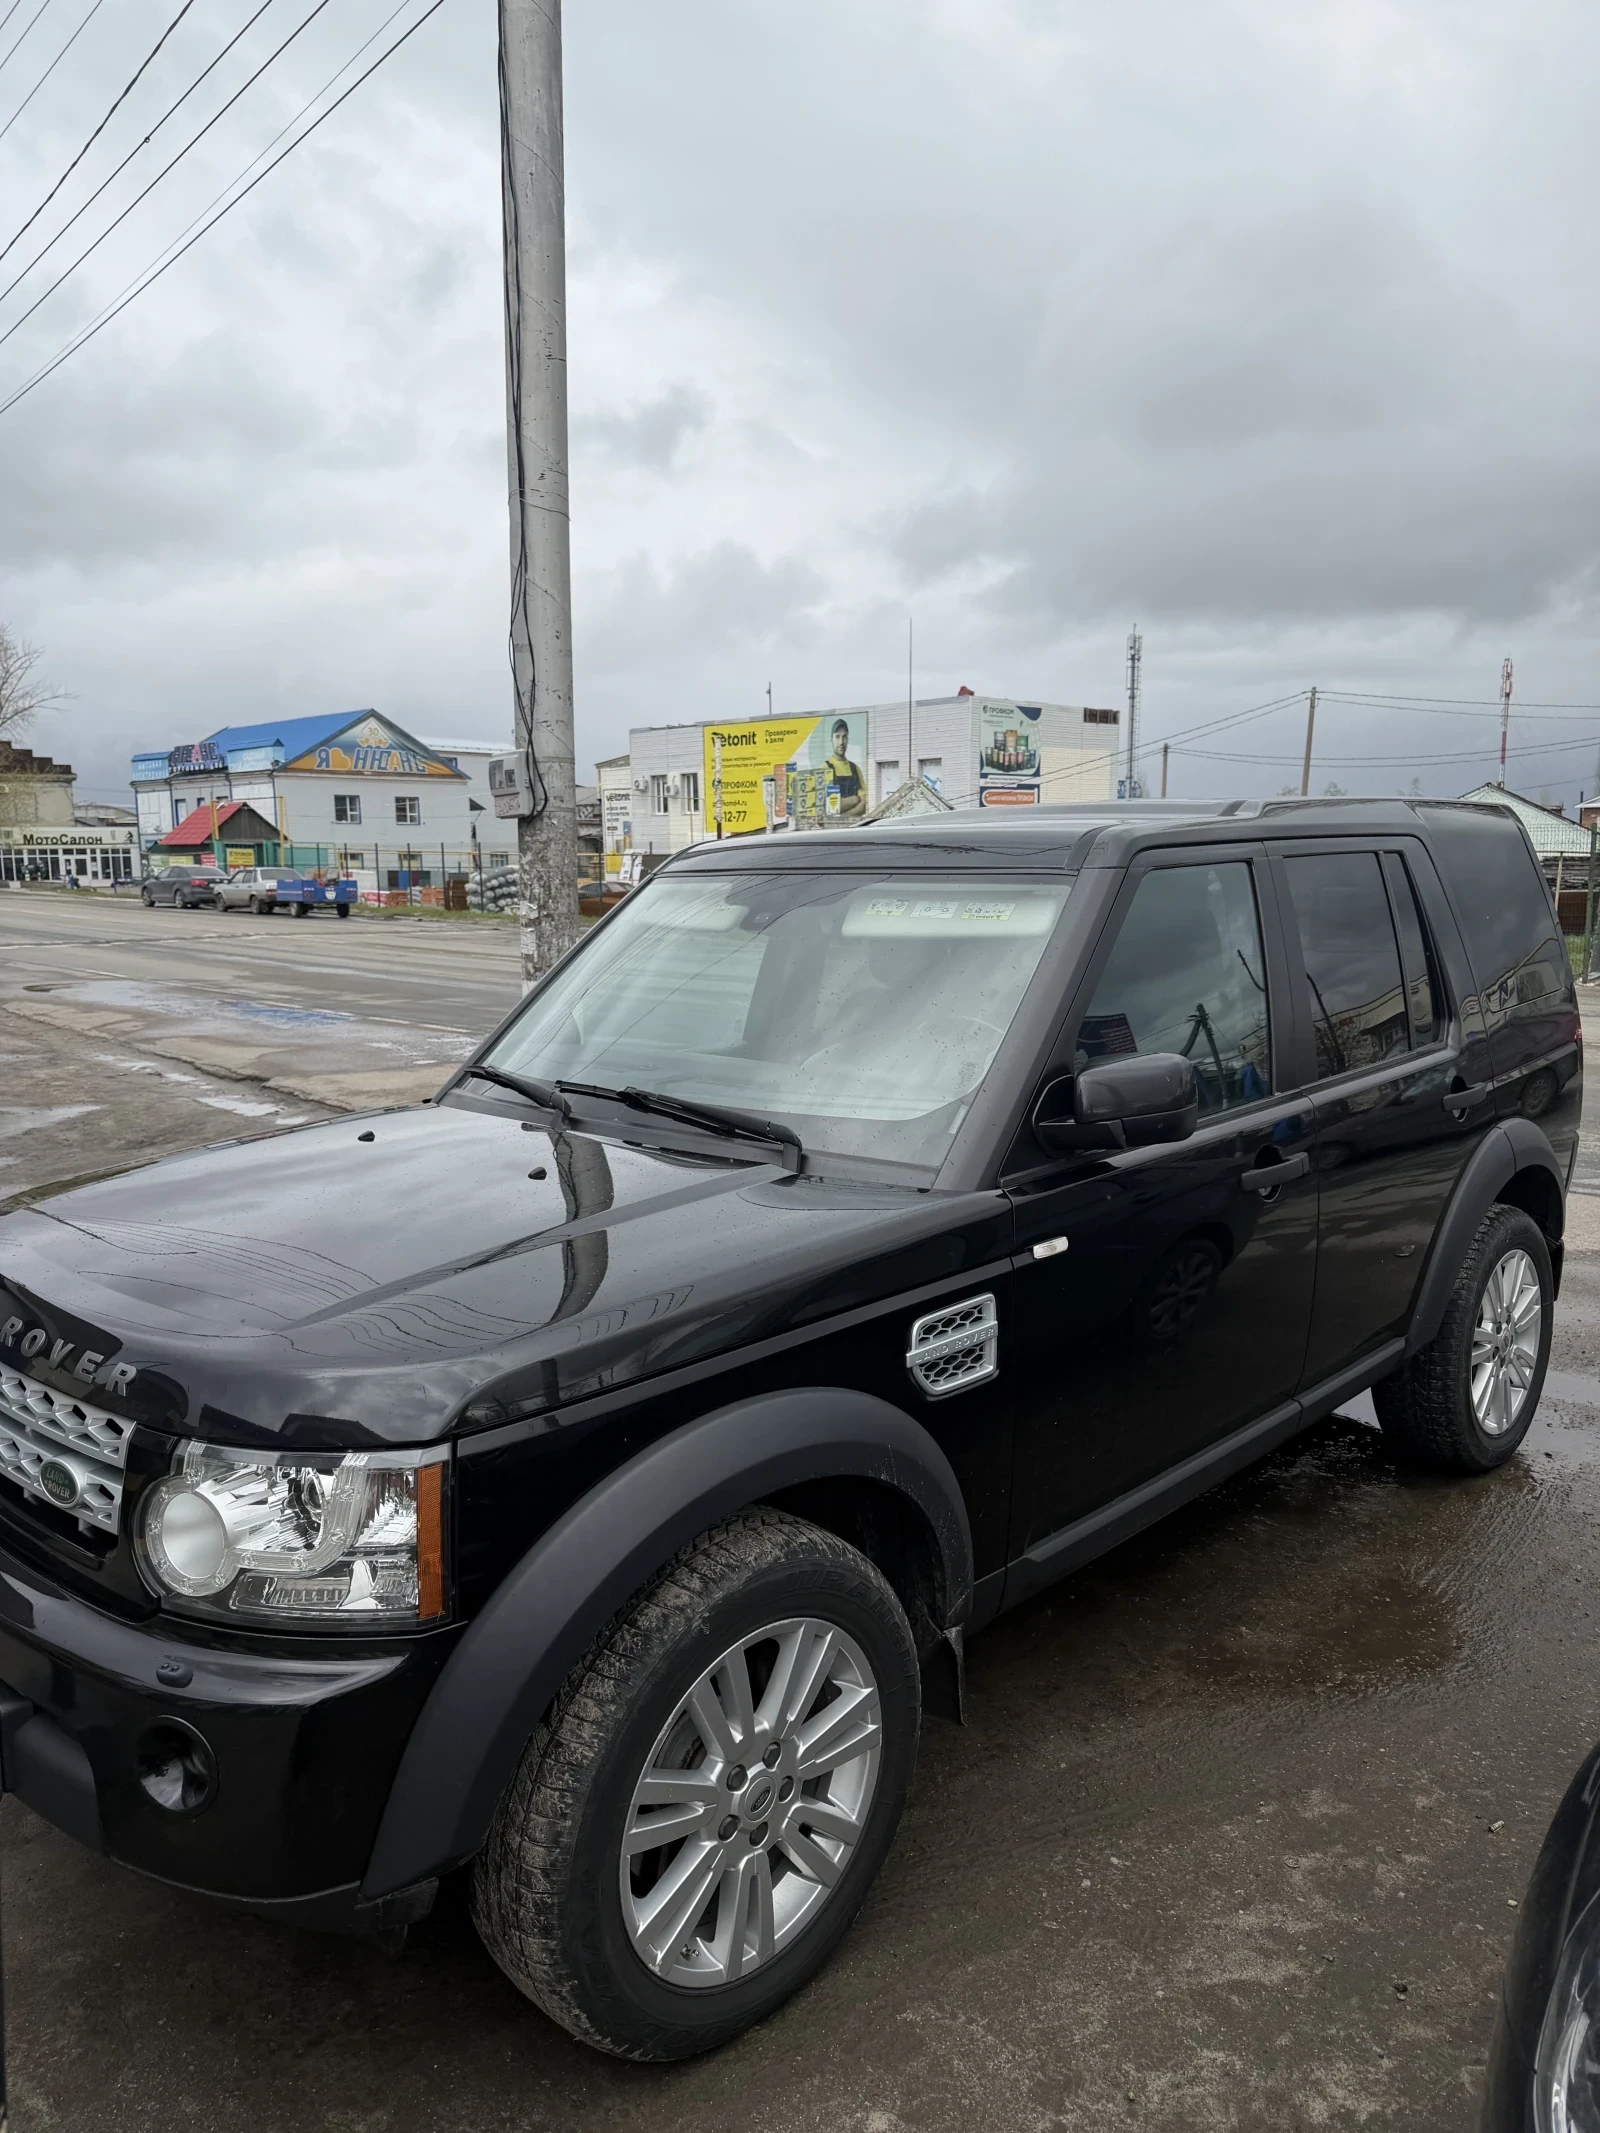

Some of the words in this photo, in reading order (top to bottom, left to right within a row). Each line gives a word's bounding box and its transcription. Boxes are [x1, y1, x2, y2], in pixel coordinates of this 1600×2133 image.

[368, 727, 379, 736] 30
[765, 729, 798, 738] Проверено
[316, 748, 330, 769] Я
[354, 747, 427, 773] НЮАНС
[721, 780, 758, 789] ПРОФКОМ
[23, 834, 103, 846] МотоСалон
[914, 1345, 949, 1364] LAND
[955, 1328, 995, 1349] ROVER
[0, 1315, 138, 1397] ROVER
[46, 1467, 65, 1484] LAND
[47, 1480, 71, 1499] ROVER
